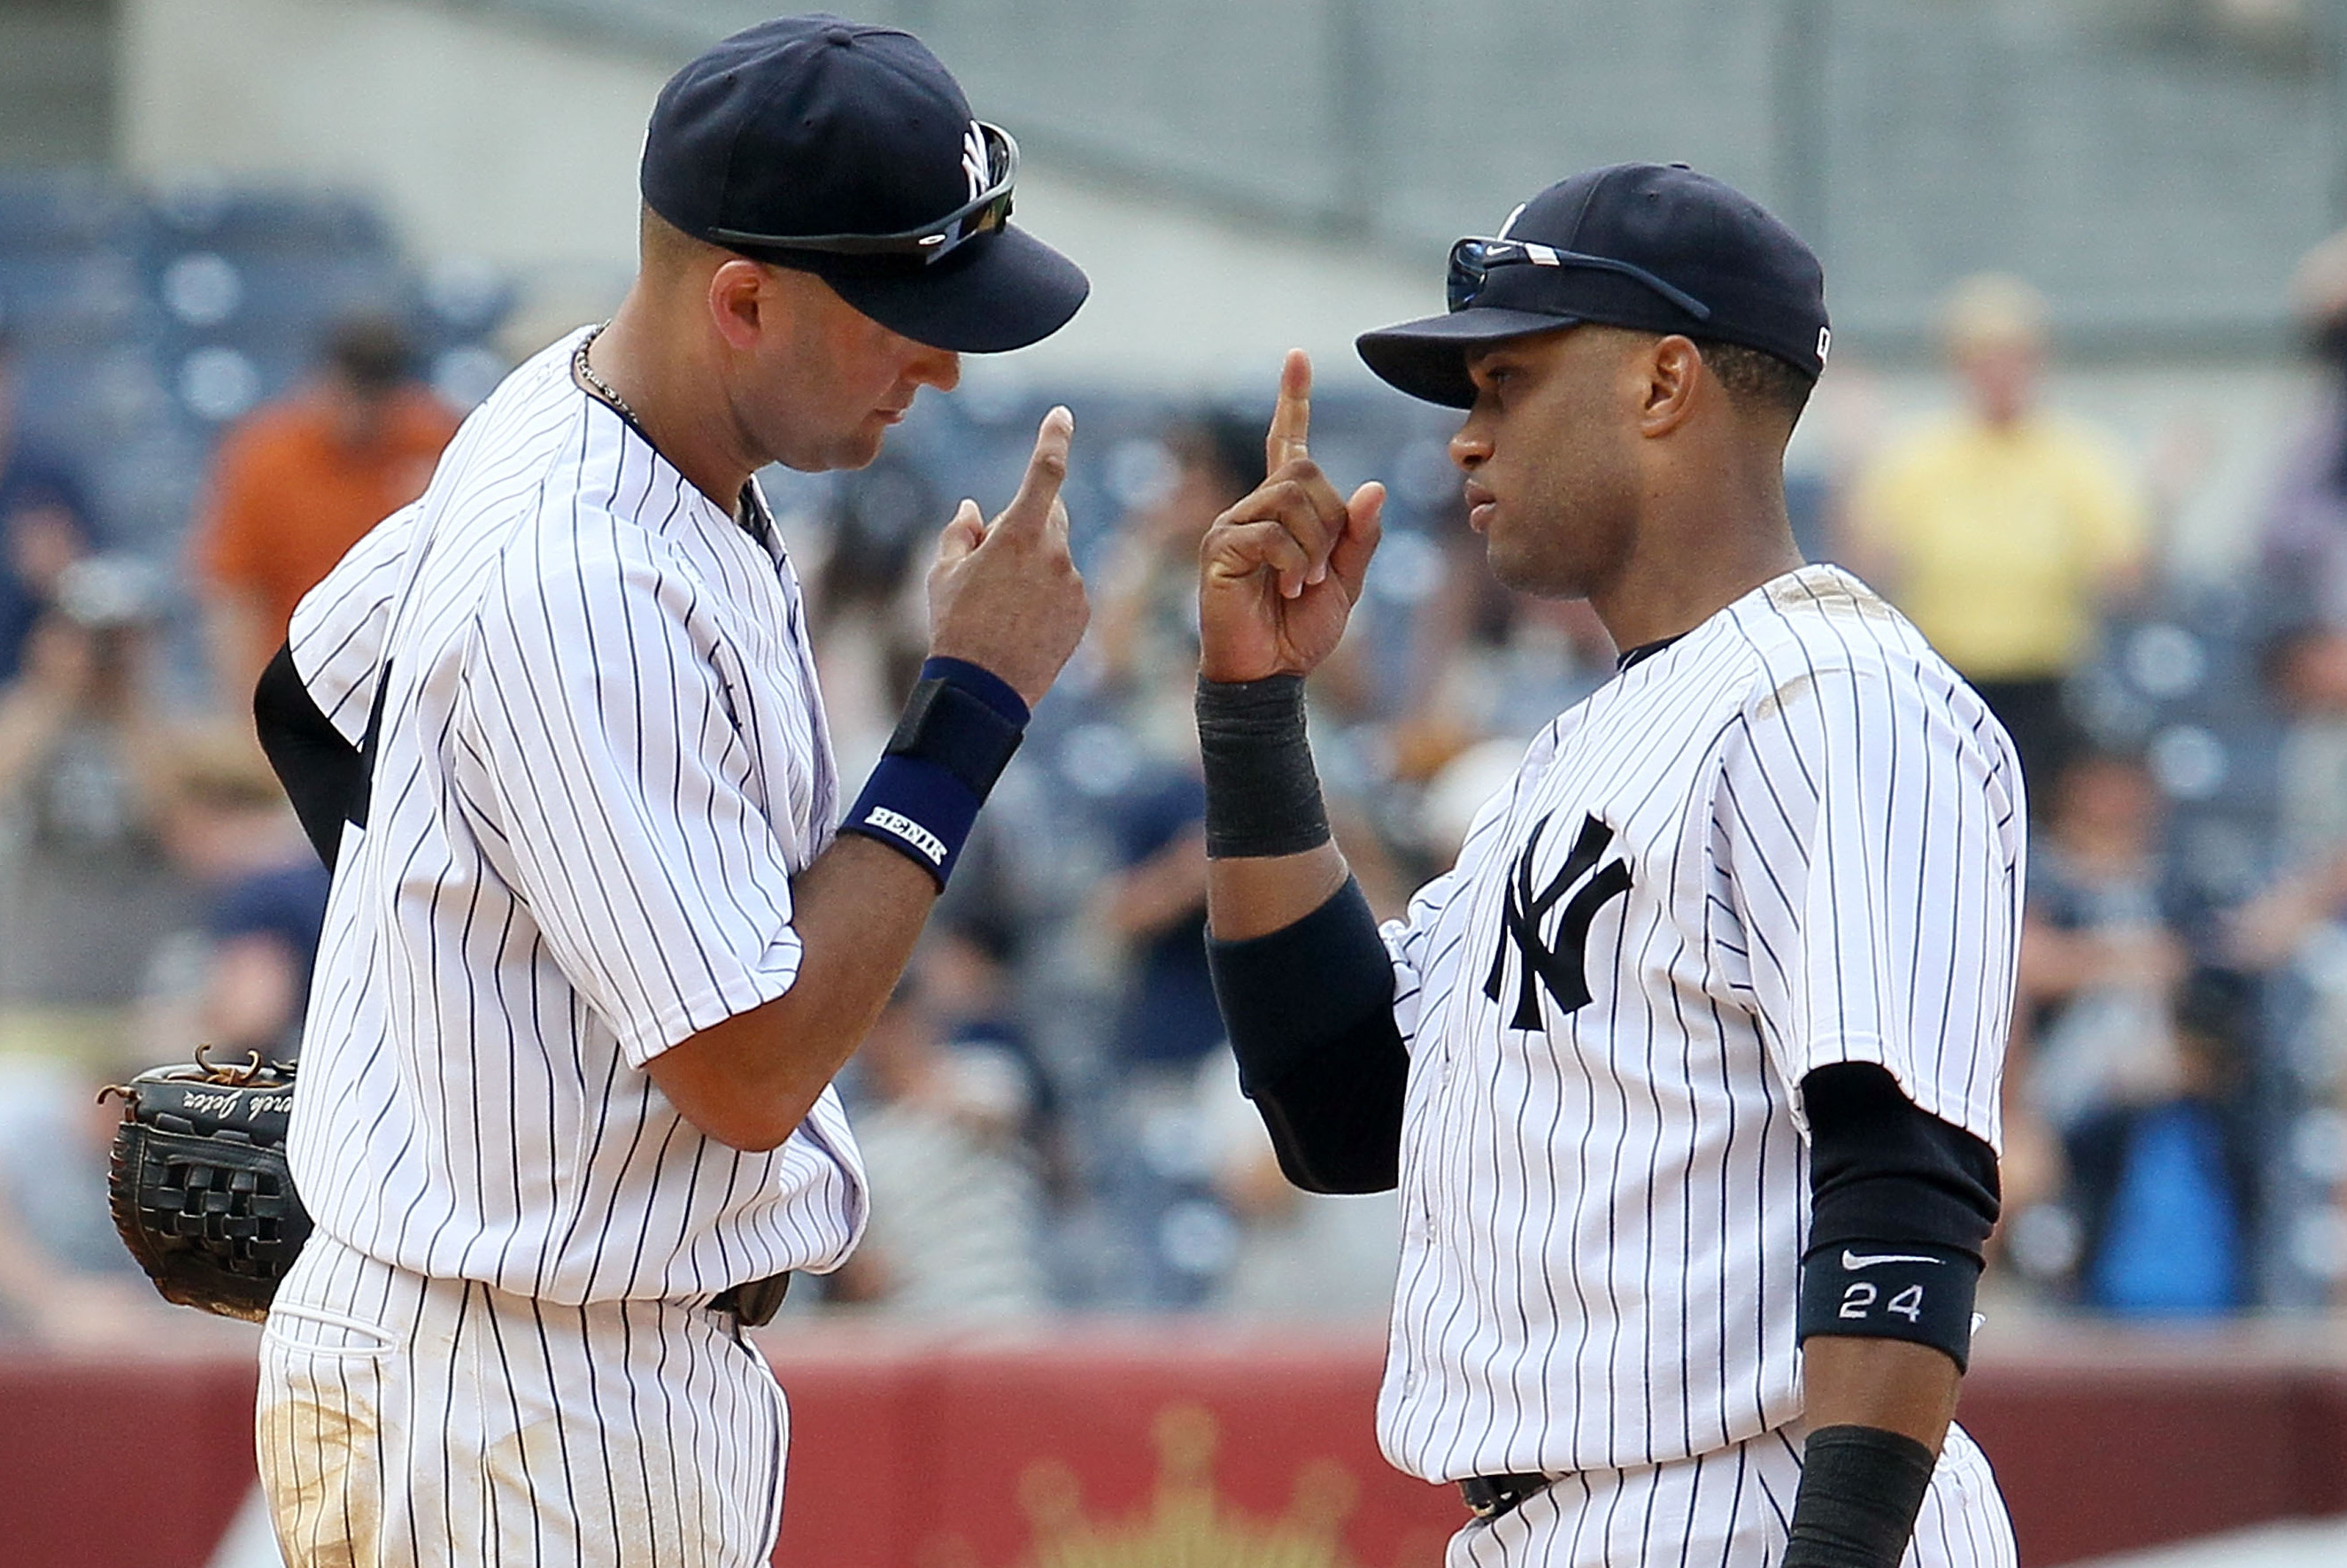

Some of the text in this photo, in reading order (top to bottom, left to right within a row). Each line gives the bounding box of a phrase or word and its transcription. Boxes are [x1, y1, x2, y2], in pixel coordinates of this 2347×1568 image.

[864, 805, 948, 866] BENIK
[1482, 808, 1634, 1031] NY
[182, 1090, 292, 1123] erek Jeter
[1839, 1281, 1925, 1323] 24
